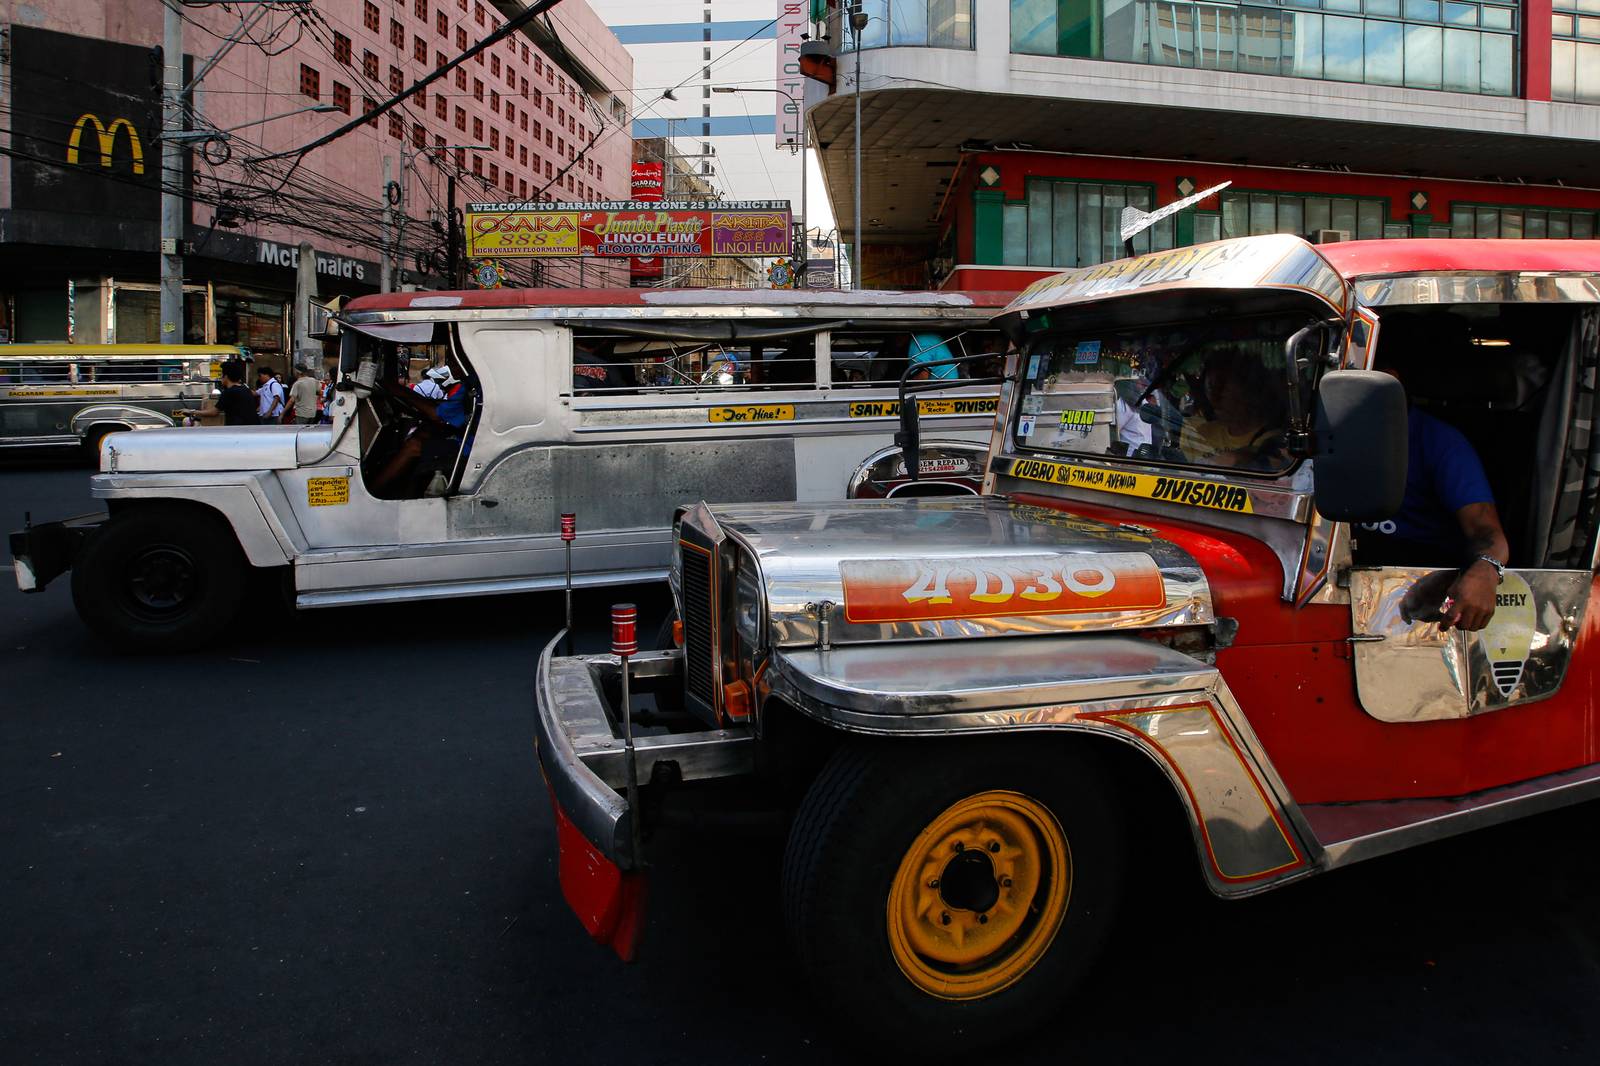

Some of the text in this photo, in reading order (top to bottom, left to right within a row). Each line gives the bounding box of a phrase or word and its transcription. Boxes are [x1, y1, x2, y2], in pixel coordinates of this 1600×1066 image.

[471, 201, 786, 212] WELCOME TO BARANGAY 268 ZONE 25 DISTRICT III
[474, 215, 577, 234] OSAKA
[594, 212, 654, 235] Jumbo
[652, 211, 705, 233] Plastic
[714, 215, 786, 230] AKITA
[499, 233, 548, 246] 888
[604, 233, 695, 243] LINOLEUM
[731, 231, 766, 242] 888
[597, 244, 702, 254] FLOORMATTING
[715, 241, 785, 254] LINOLEUM
[722, 408, 746, 421] For
[854, 403, 884, 416] SAN
[1061, 409, 1095, 425] CUBAO
[937, 458, 965, 467] REPAIR
[1014, 459, 1056, 481] CUBAO
[1071, 468, 1084, 482] STA
[1085, 470, 1104, 484] MESA
[1105, 473, 1137, 490] AVENIDA
[1151, 477, 1248, 511] DIVISORIA
[1496, 593, 1527, 607] REFLY
